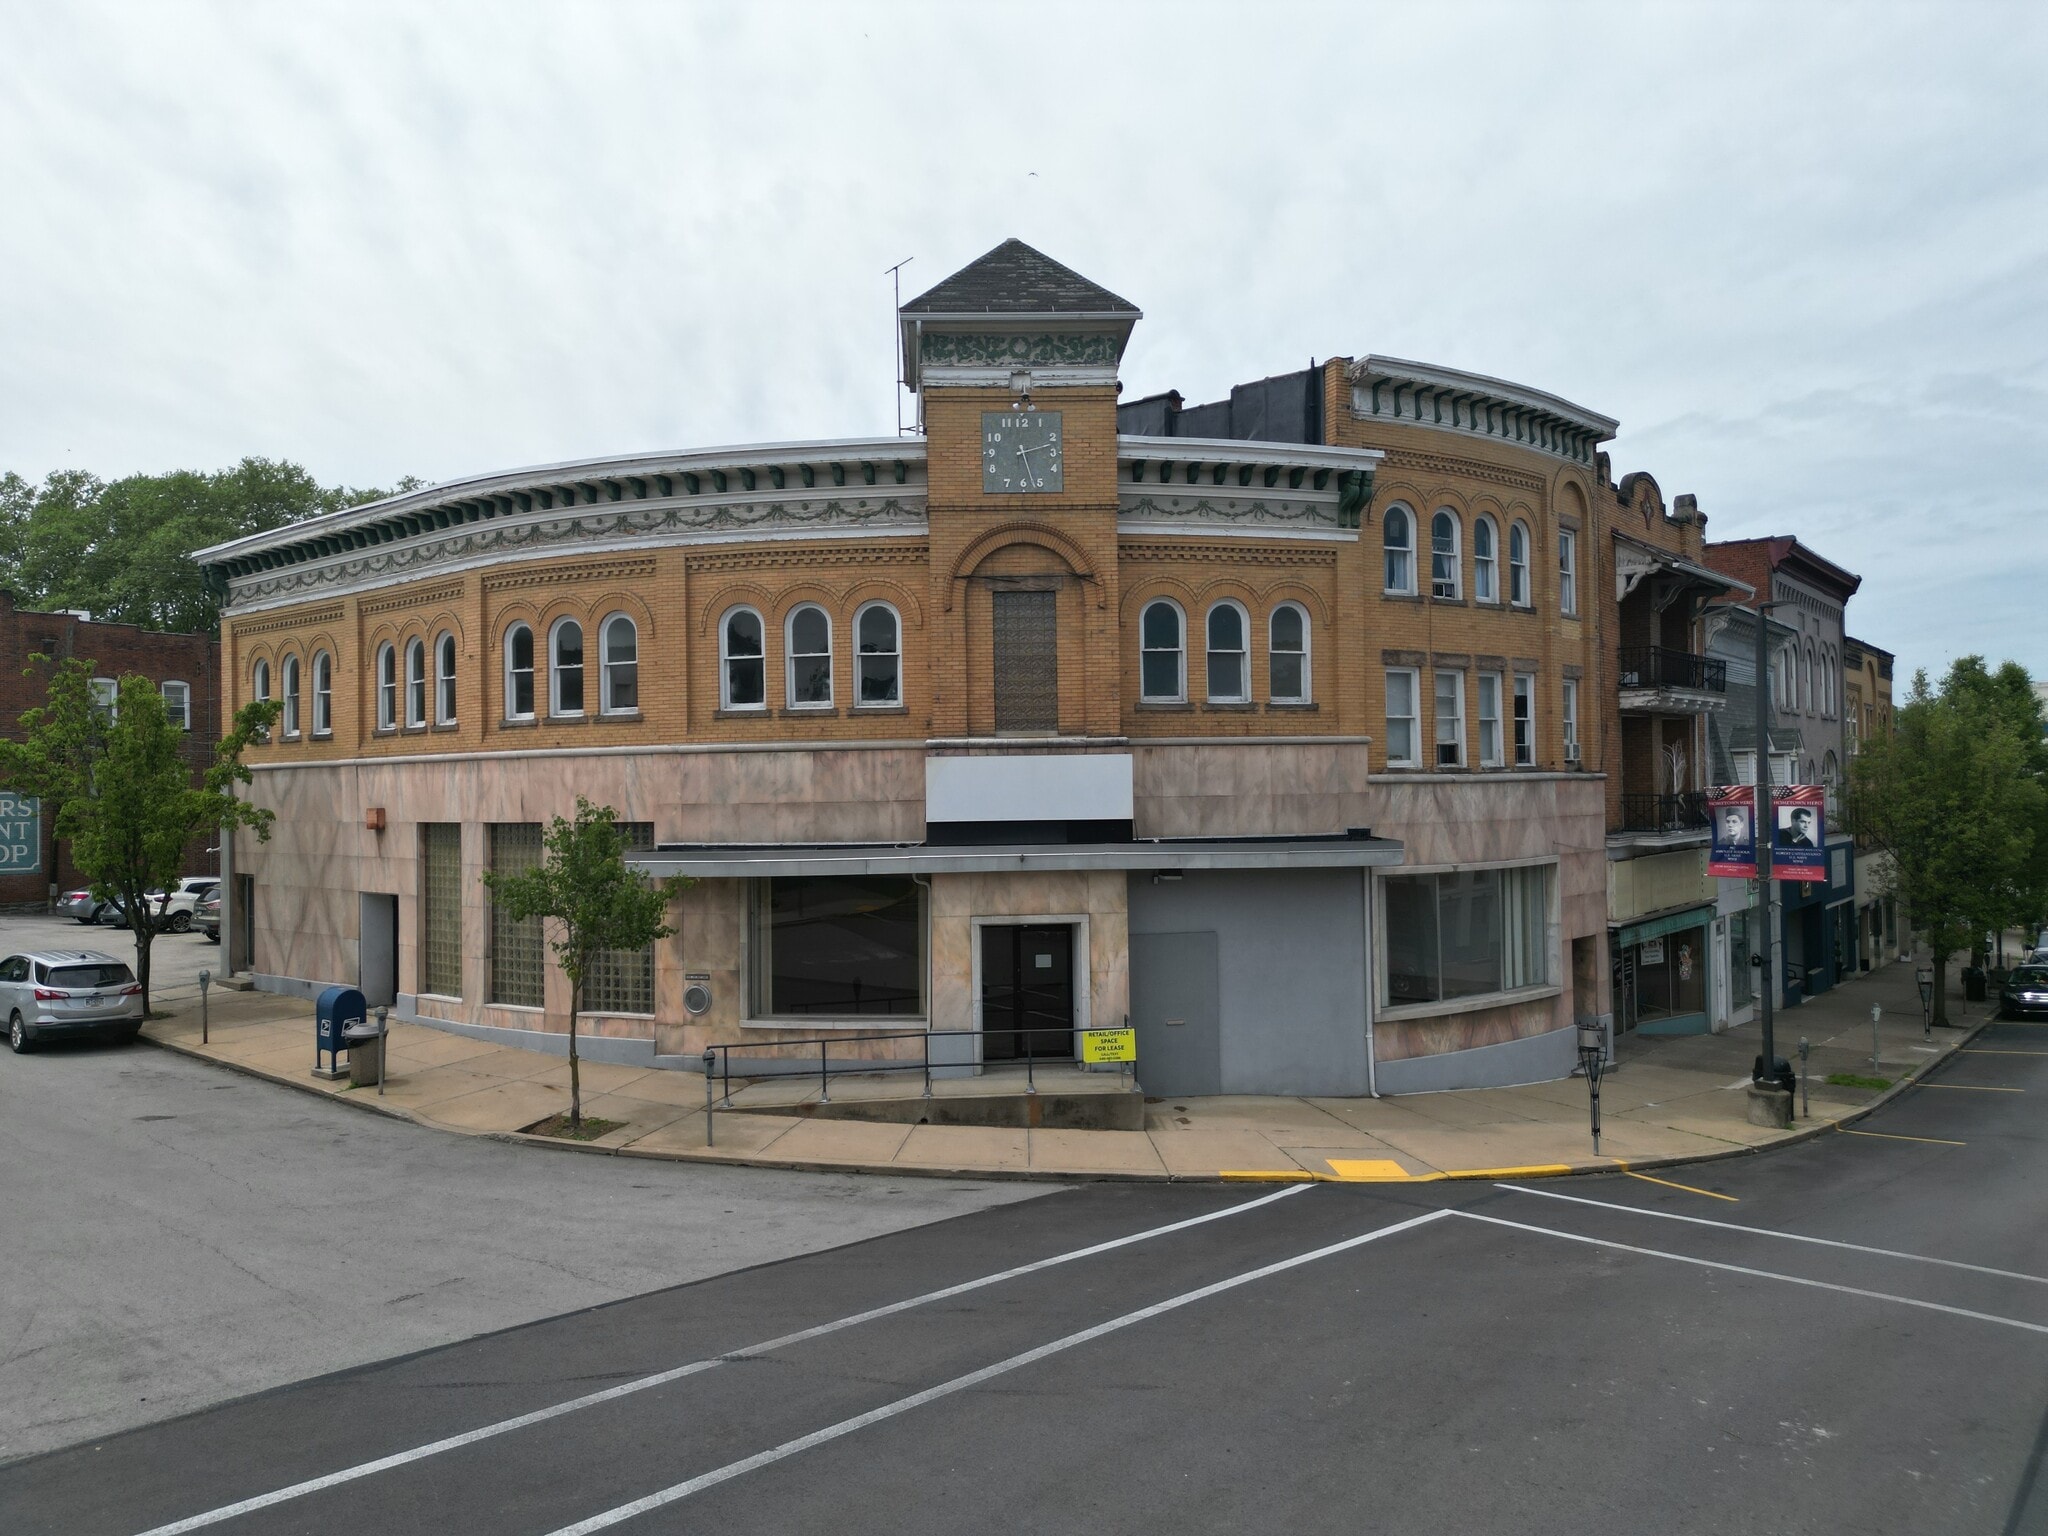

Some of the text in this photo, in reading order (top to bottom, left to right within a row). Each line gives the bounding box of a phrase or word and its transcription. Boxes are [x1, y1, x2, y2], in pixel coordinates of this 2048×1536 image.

[1001, 418, 1011, 428] 11
[1015, 418, 1029, 428] 12
[987, 433, 1002, 442] 10
[1049, 432, 1057, 441] 2
[988, 448, 995, 458] 9
[1049, 448, 1057, 457] 3
[989, 464, 996, 473] 8
[1050, 463, 1057, 473] 4
[1003, 478, 1011, 488] 7
[1020, 478, 1027, 487] 6
[1036, 478, 1044, 487] 5
